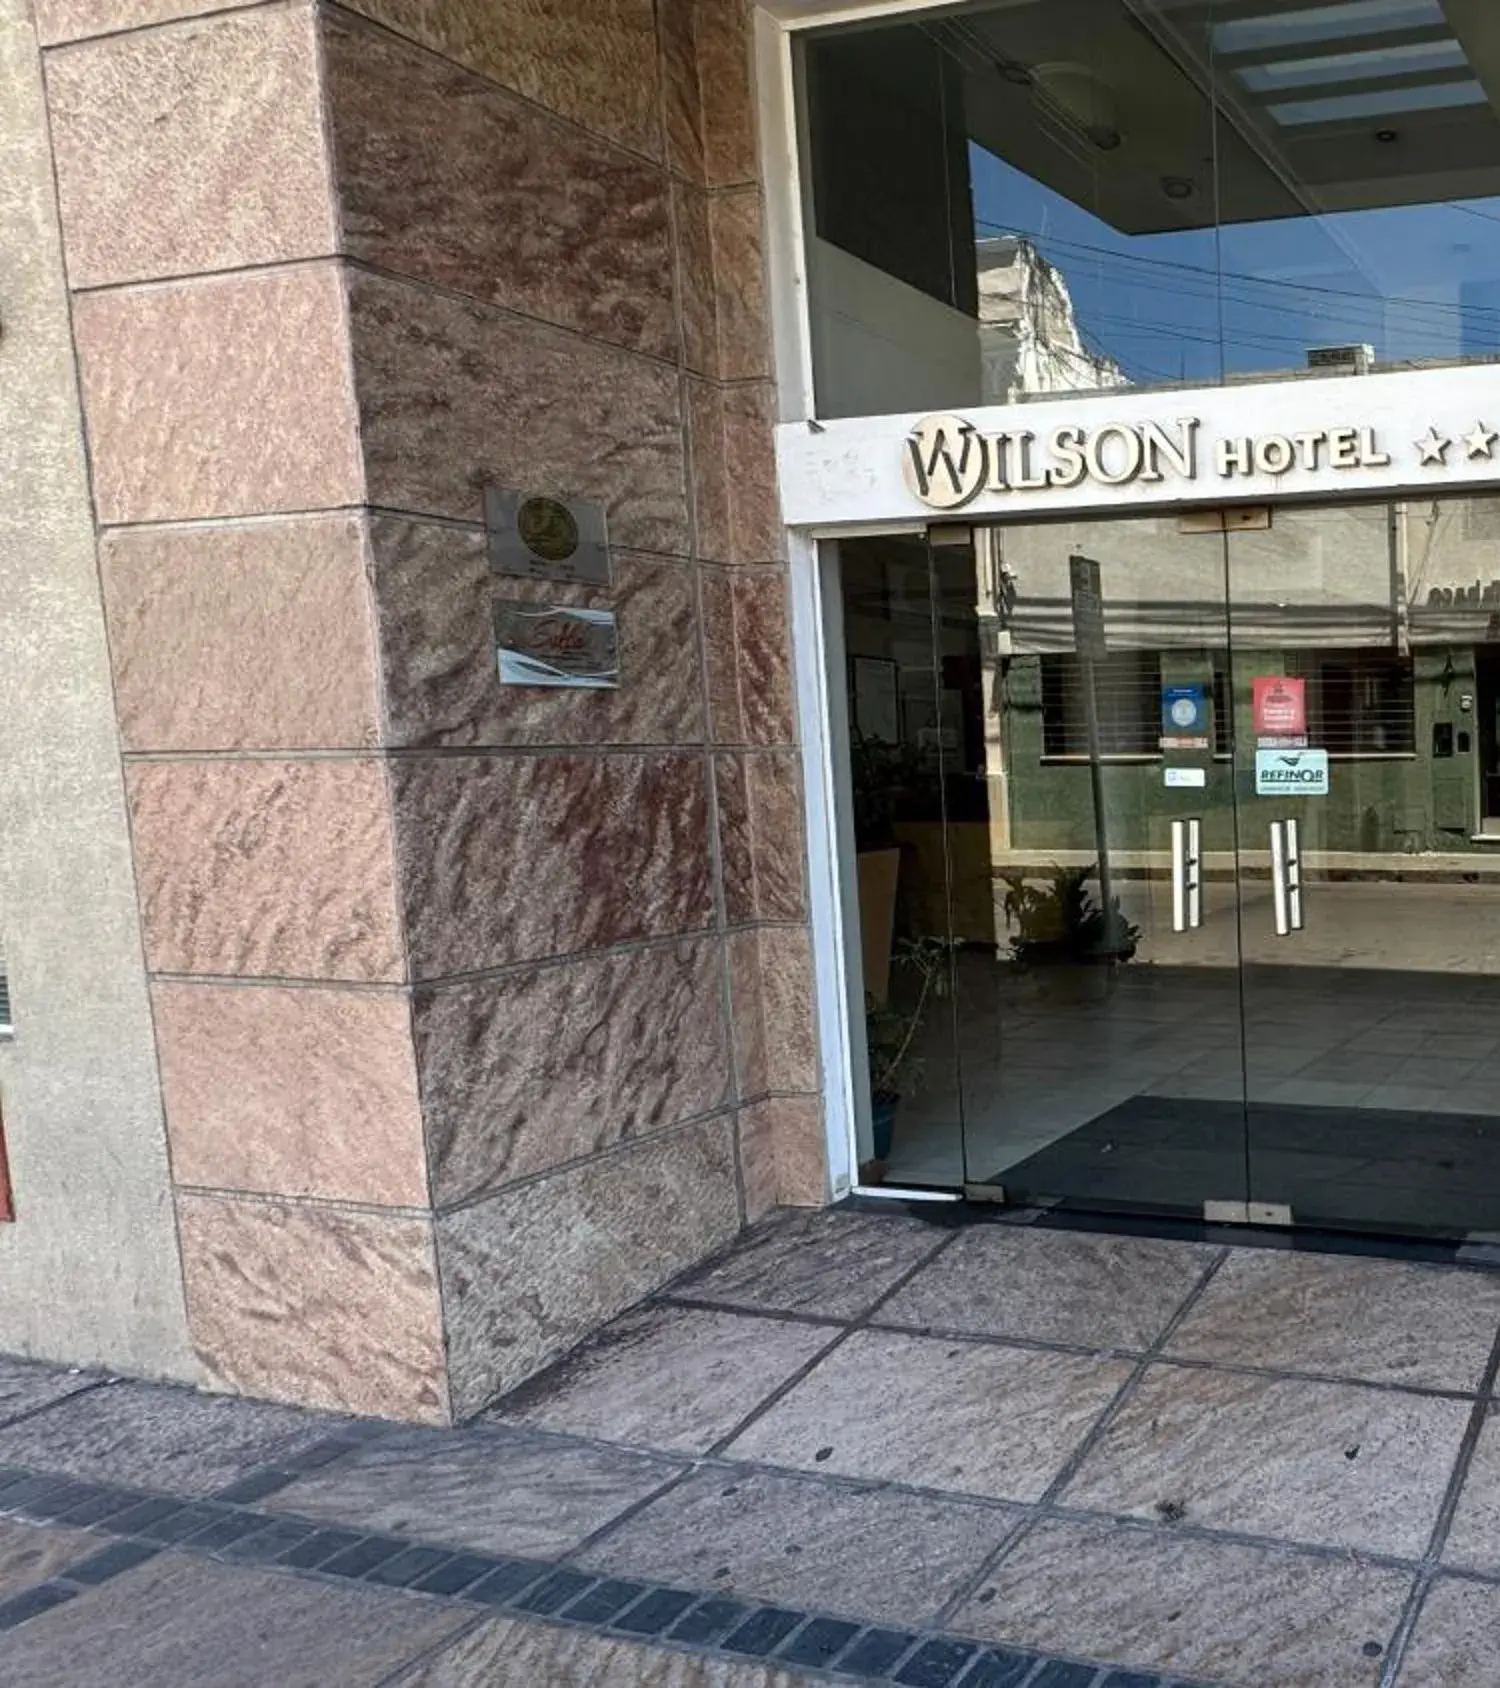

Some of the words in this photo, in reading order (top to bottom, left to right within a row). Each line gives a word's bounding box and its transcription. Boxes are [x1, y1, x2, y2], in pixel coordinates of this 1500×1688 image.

[904, 414, 1199, 508] WILSON
[1216, 426, 1390, 478] HOTEL
[1260, 769, 1324, 783] REFINOR
